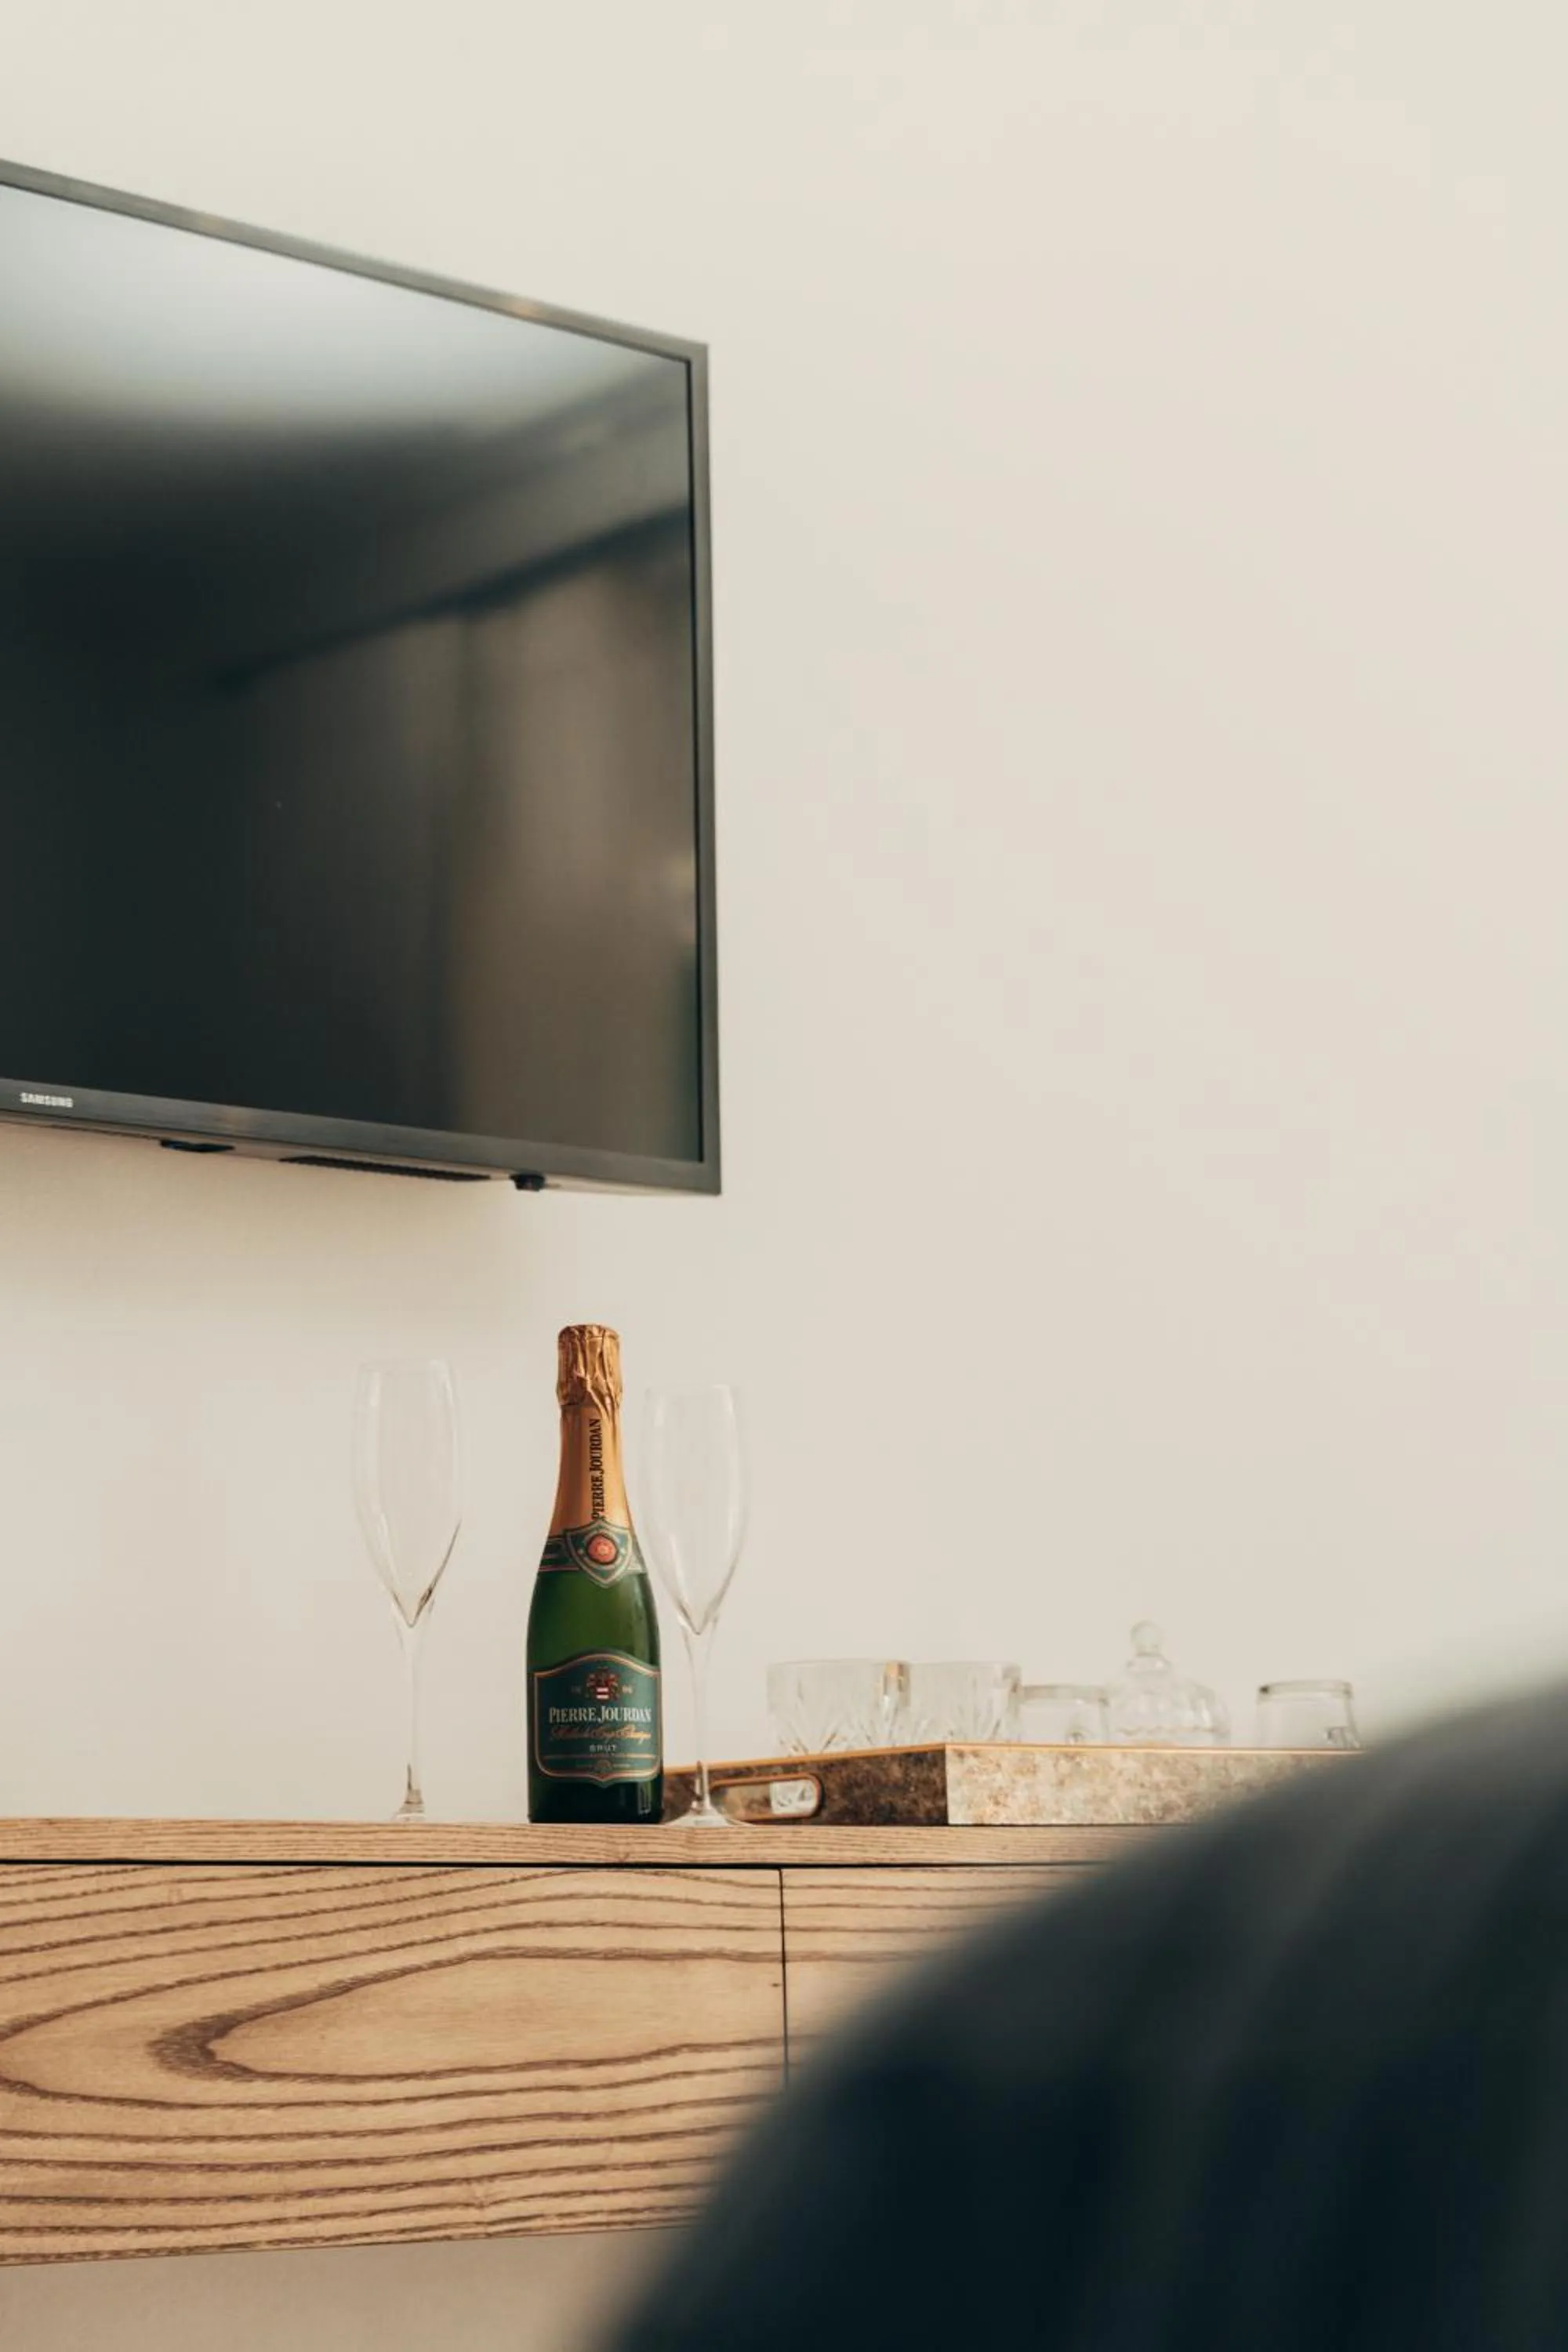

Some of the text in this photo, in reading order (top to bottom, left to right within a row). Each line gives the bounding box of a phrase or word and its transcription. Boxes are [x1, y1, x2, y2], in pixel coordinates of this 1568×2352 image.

[20, 1092, 74, 1108] SAMSUNG
[590, 1418, 604, 1519] PIERRE JOURDAN
[550, 1706, 652, 1723] PIERRE JOURDAN
